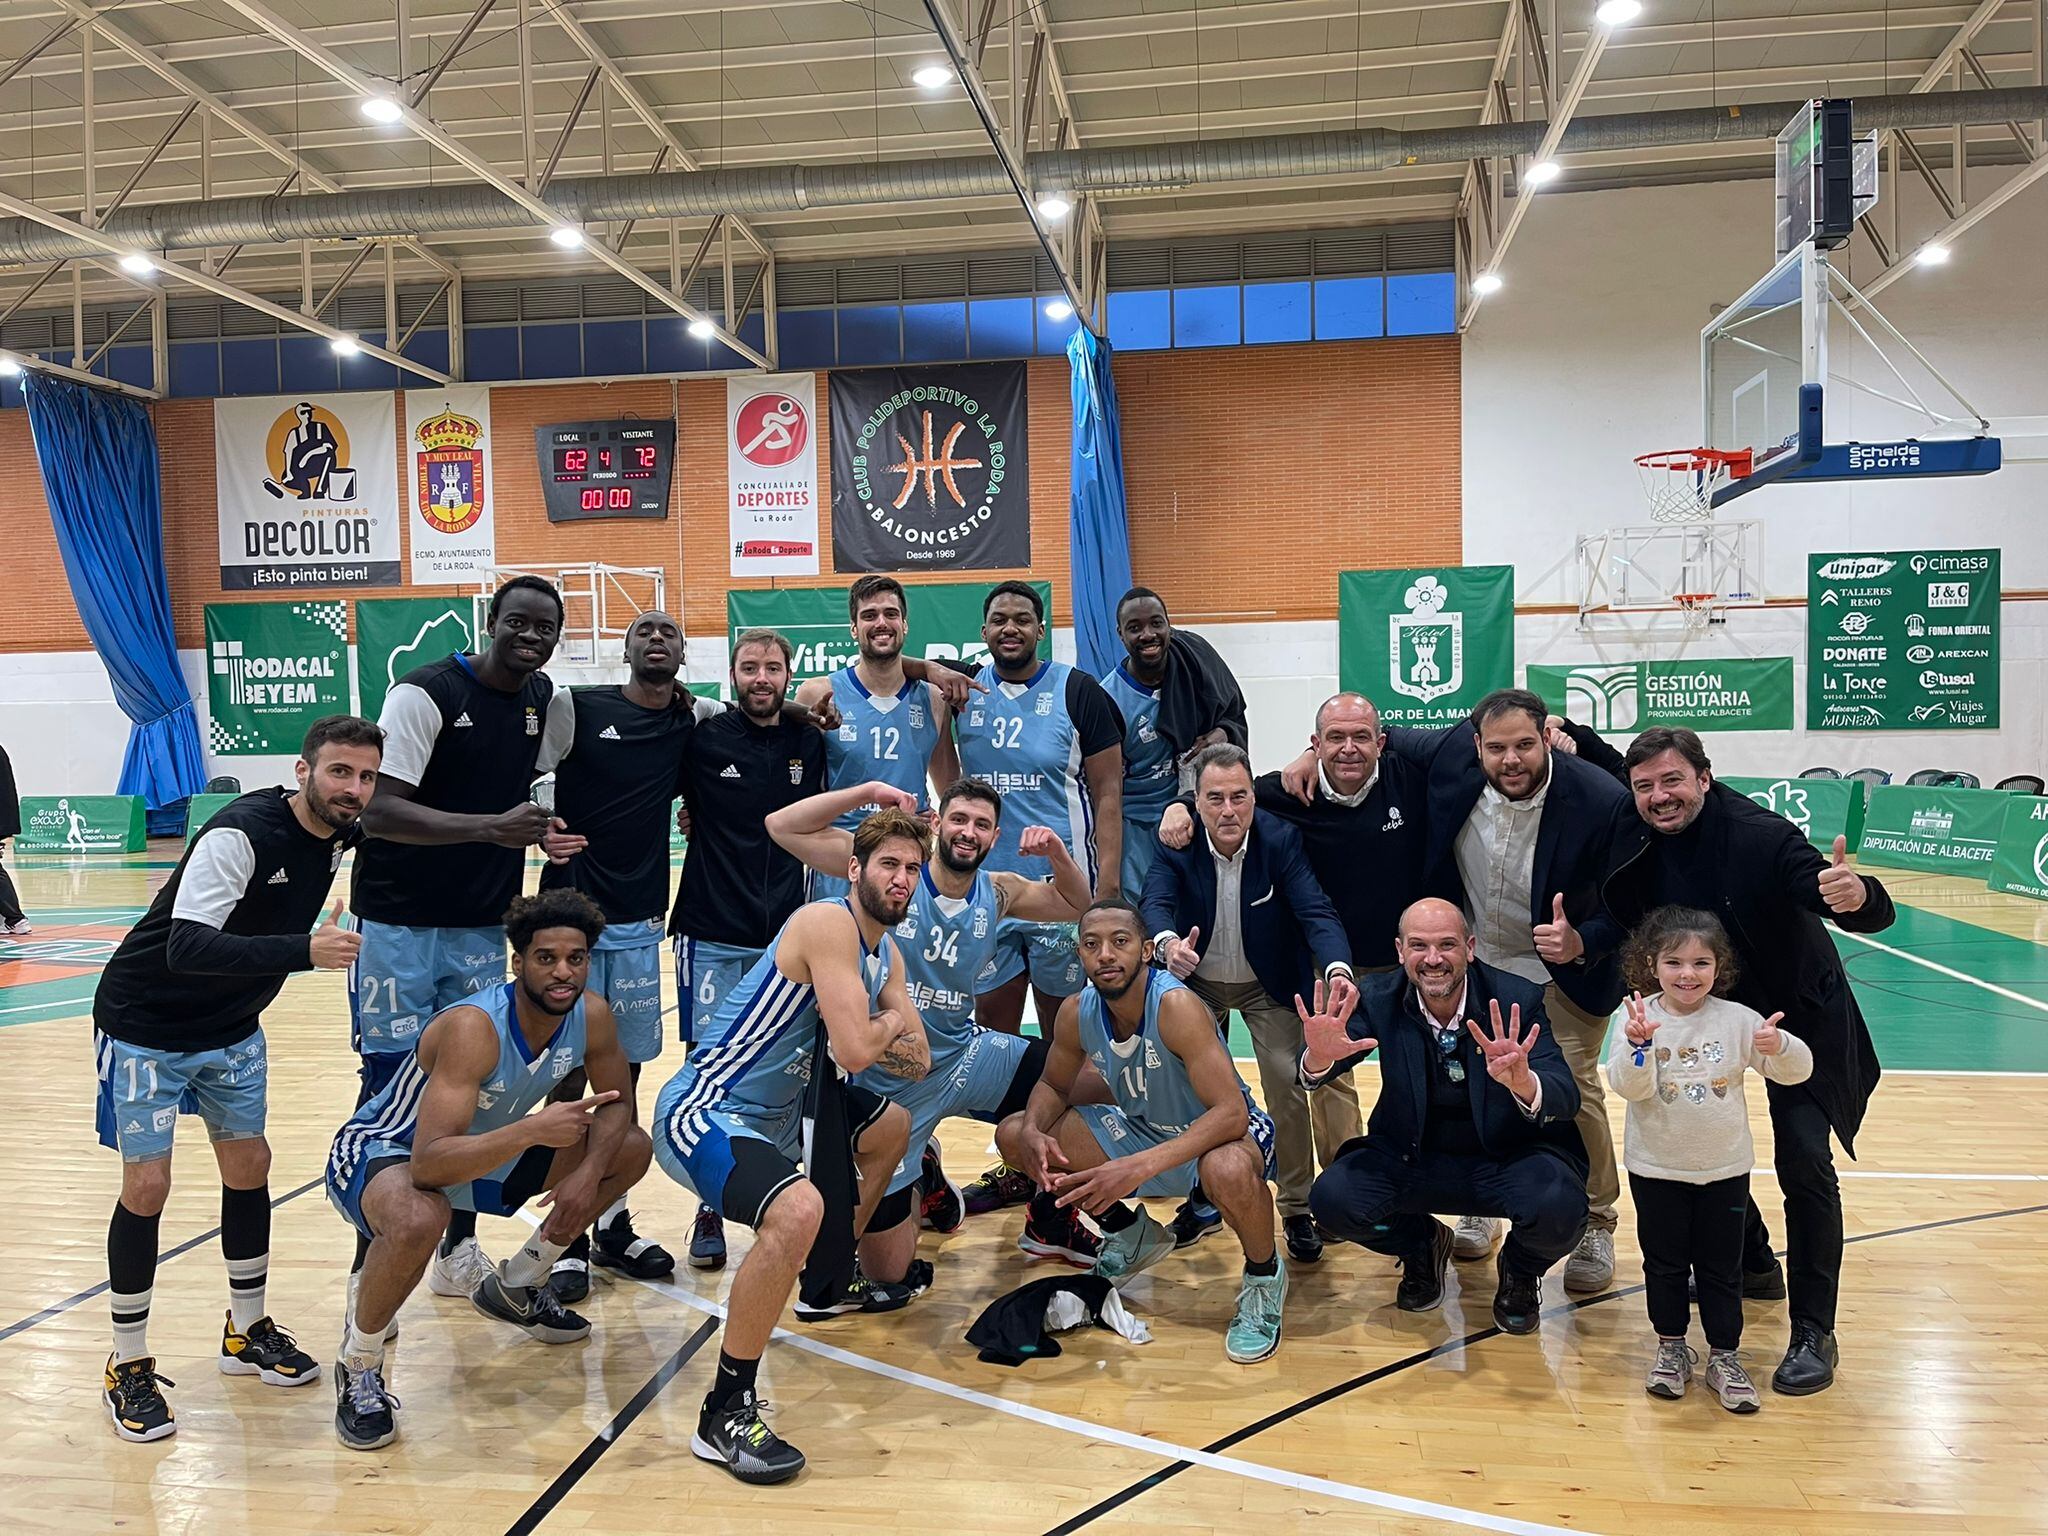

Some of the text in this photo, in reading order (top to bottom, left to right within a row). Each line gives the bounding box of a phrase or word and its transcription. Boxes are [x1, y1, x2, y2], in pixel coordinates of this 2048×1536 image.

[622, 430, 653, 438] VISITANTE
[853, 386, 1005, 500] CLUB POLIDEPORTIVO LA RODA
[433, 453, 451, 462] MUY
[452, 452, 474, 461] LEAL
[565, 447, 656, 470] 62 4 72
[1849, 446, 1920, 458] Schelde
[1849, 457, 1920, 471] Sports
[420, 463, 429, 495] NOBLE
[473, 463, 481, 492] VILLA
[431, 482, 469, 495] R F
[737, 480, 808, 490] CONCEJALÍA DE
[737, 491, 809, 507] DEPORTES
[303, 508, 369, 517] PINTURAS
[768, 514, 793, 522] Roda
[870, 504, 992, 545] BALONCESTO
[438, 549, 492, 558] AYUNTAMIENTO
[906, 549, 956, 560] Desde 1969
[433, 562, 475, 571] DE LA RODA
[1830, 561, 1884, 577] Unipar
[1929, 555, 1988, 570] cimasa
[253, 566, 368, 587] ¡Esto pinta bien!
[1840, 587, 1892, 597] TALLERES
[1931, 585, 1968, 598] J & C
[1850, 598, 1881, 607] REMO
[1402, 626, 1449, 638] Hotel
[1928, 625, 1991, 636] FONDA ORIENTAL
[1823, 648, 1888, 661] DONATE
[1937, 650, 1989, 658] AREXCAN
[1645, 671, 1722, 691] GESTIÓN
[1938, 671, 1975, 686] lusal
[245, 682, 317, 705] BEYEM
[1645, 690, 1751, 709] TRIBUTARIA
[1949, 700, 1984, 712] Viajes
[1378, 708, 1474, 720] LOR DE LA MAN
[1647, 708, 1753, 719] PROVINCIAL DE ALBACETE
[1949, 713, 1987, 726] Mugar
[1821, 714, 1880, 727] MUNERA
[991, 717, 1023, 749] 32
[869, 725, 900, 760] 12
[38, 809, 65, 818] Grupo
[1863, 836, 1995, 862] DIPUTACIÓN DE ALBACETE
[2006, 883, 2040, 896] MATERIALES
[923, 925, 960, 968] 34
[699, 970, 716, 1005] 6
[904, 981, 969, 1005] alasur
[362, 976, 399, 1014] 21
[123, 1056, 158, 1102] 11
[1119, 1065, 1149, 1101] 14
[1105, 1116, 1121, 1138] CRC
